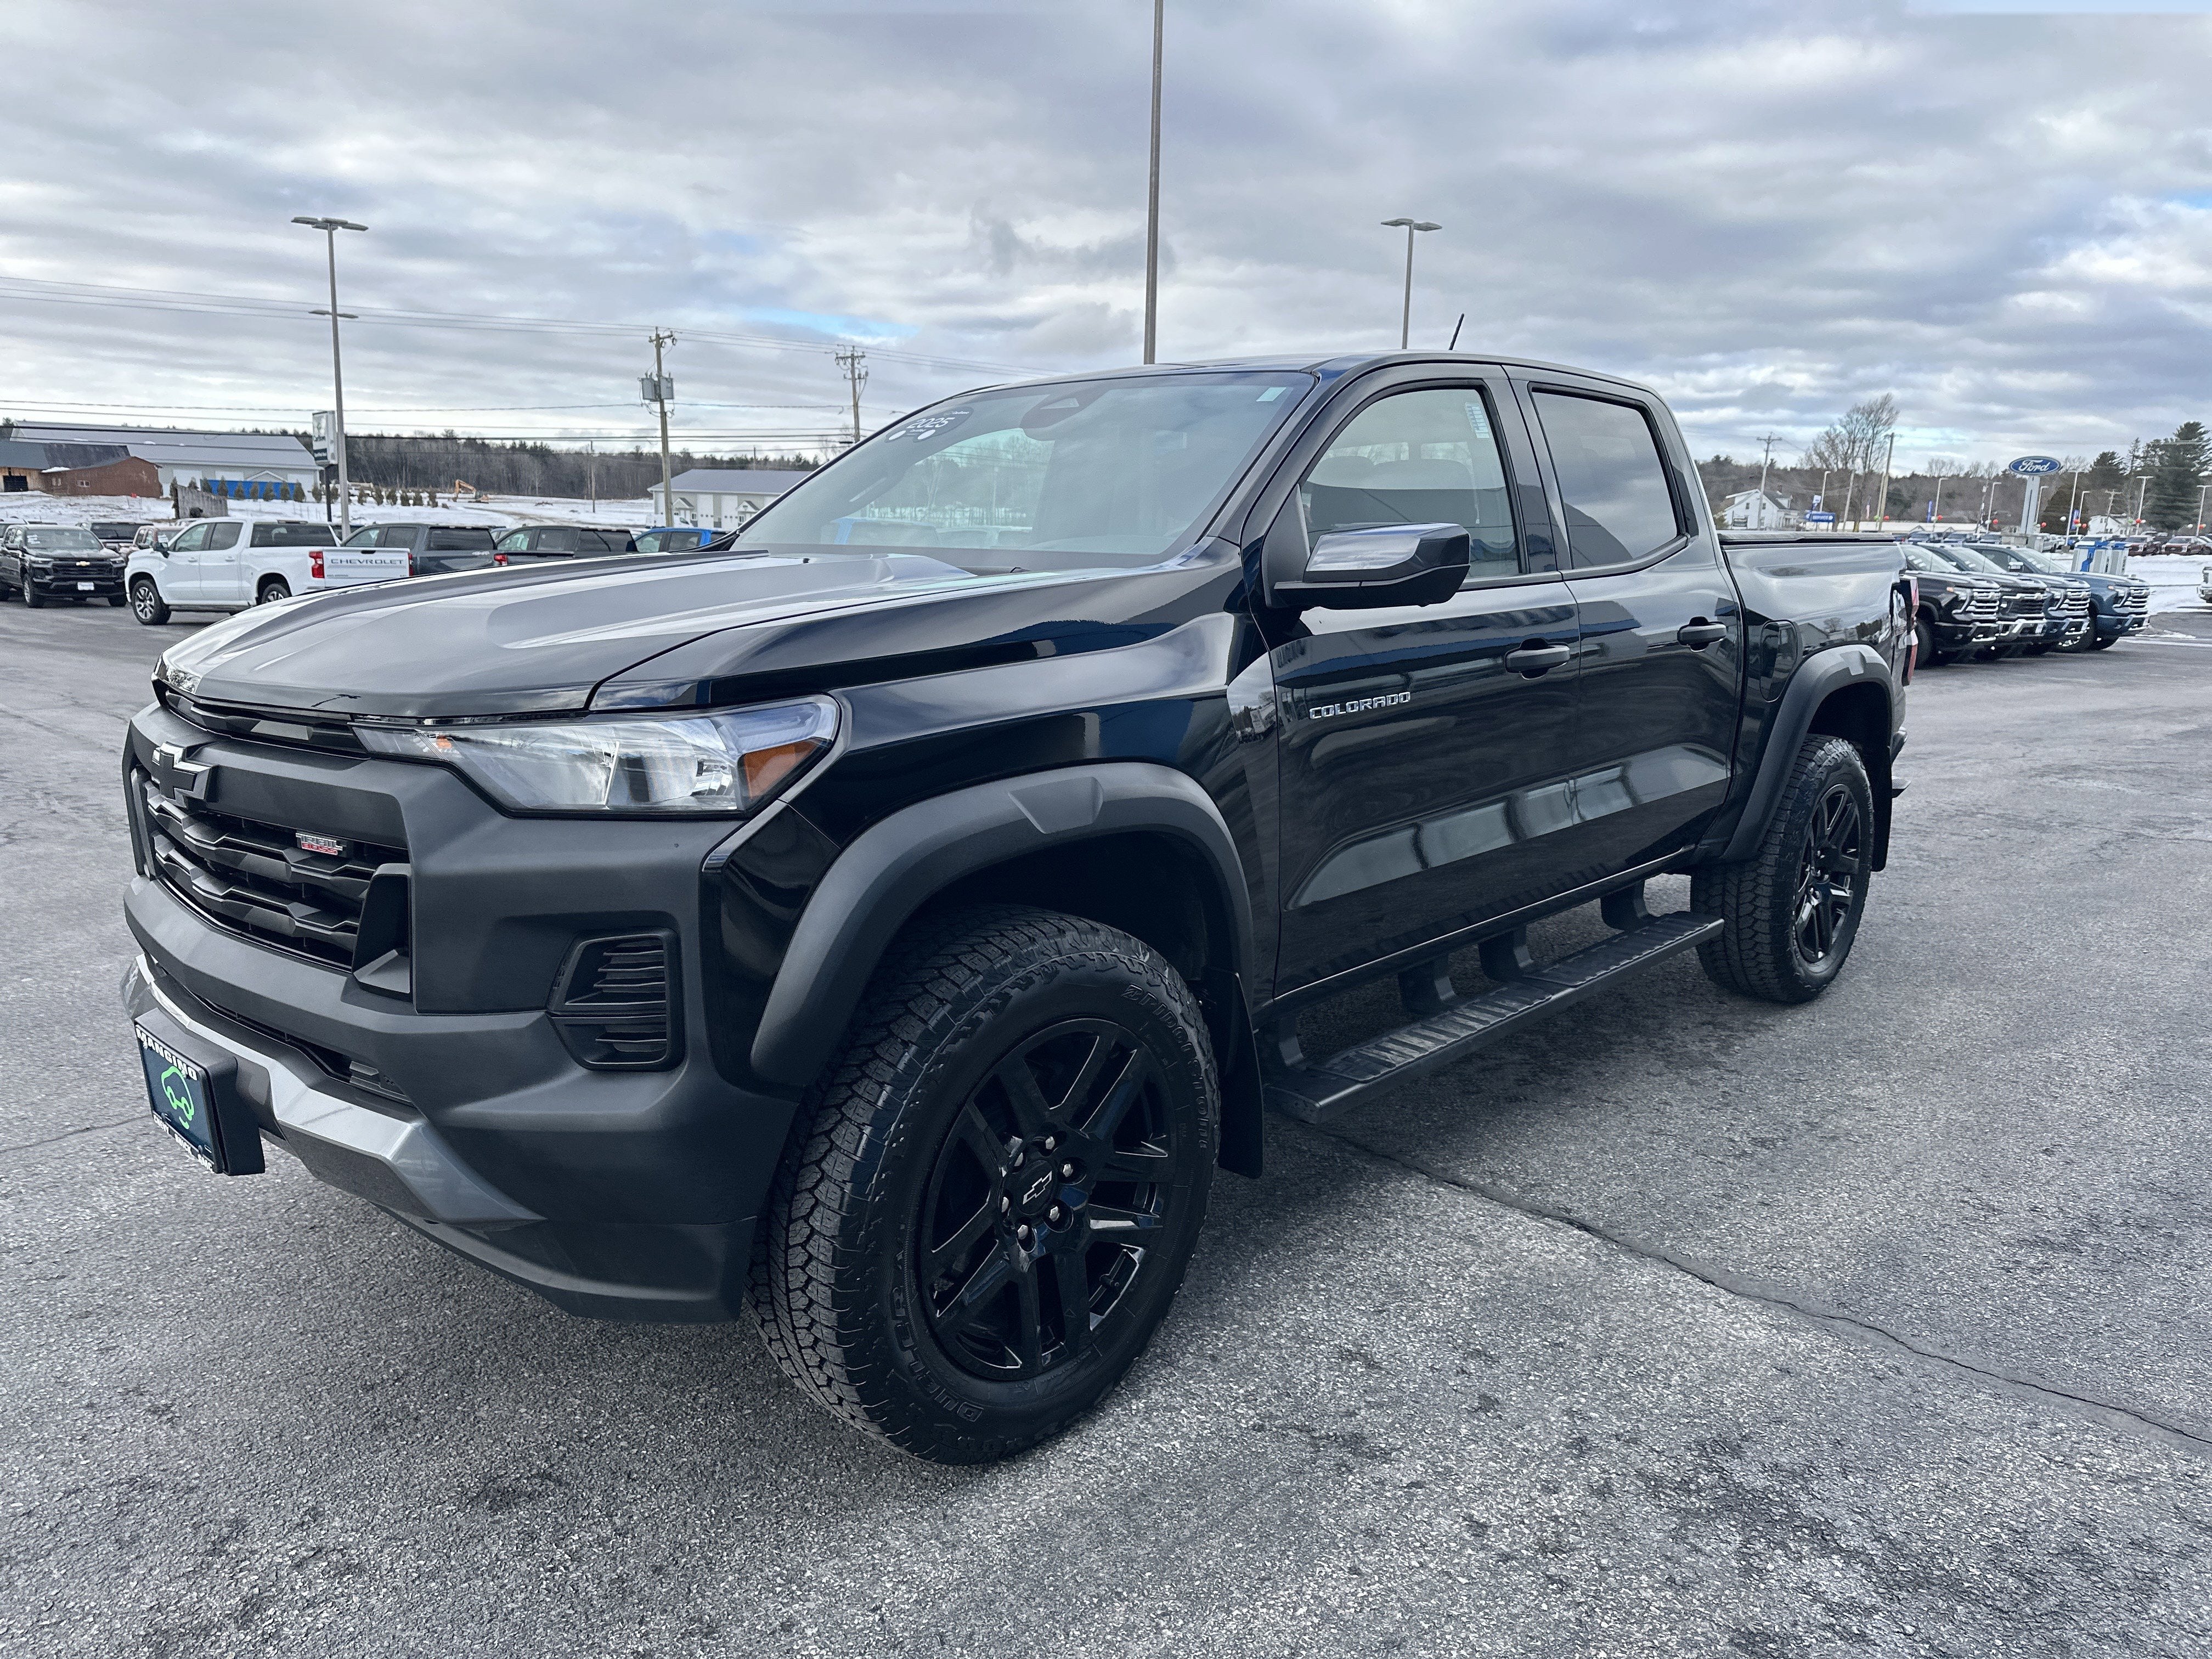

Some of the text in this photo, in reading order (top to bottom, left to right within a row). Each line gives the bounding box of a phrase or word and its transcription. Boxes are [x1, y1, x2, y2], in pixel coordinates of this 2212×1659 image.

[906, 417, 956, 429] 2025
[2019, 459, 2051, 472] Ford
[1310, 691, 1411, 719] COLORADO
[295, 832, 343, 851] TRAIL
[301, 842, 338, 855] BOSS
[136, 1028, 198, 1081] MANGINO
[1121, 984, 1209, 1149] BRIDGESTONE
